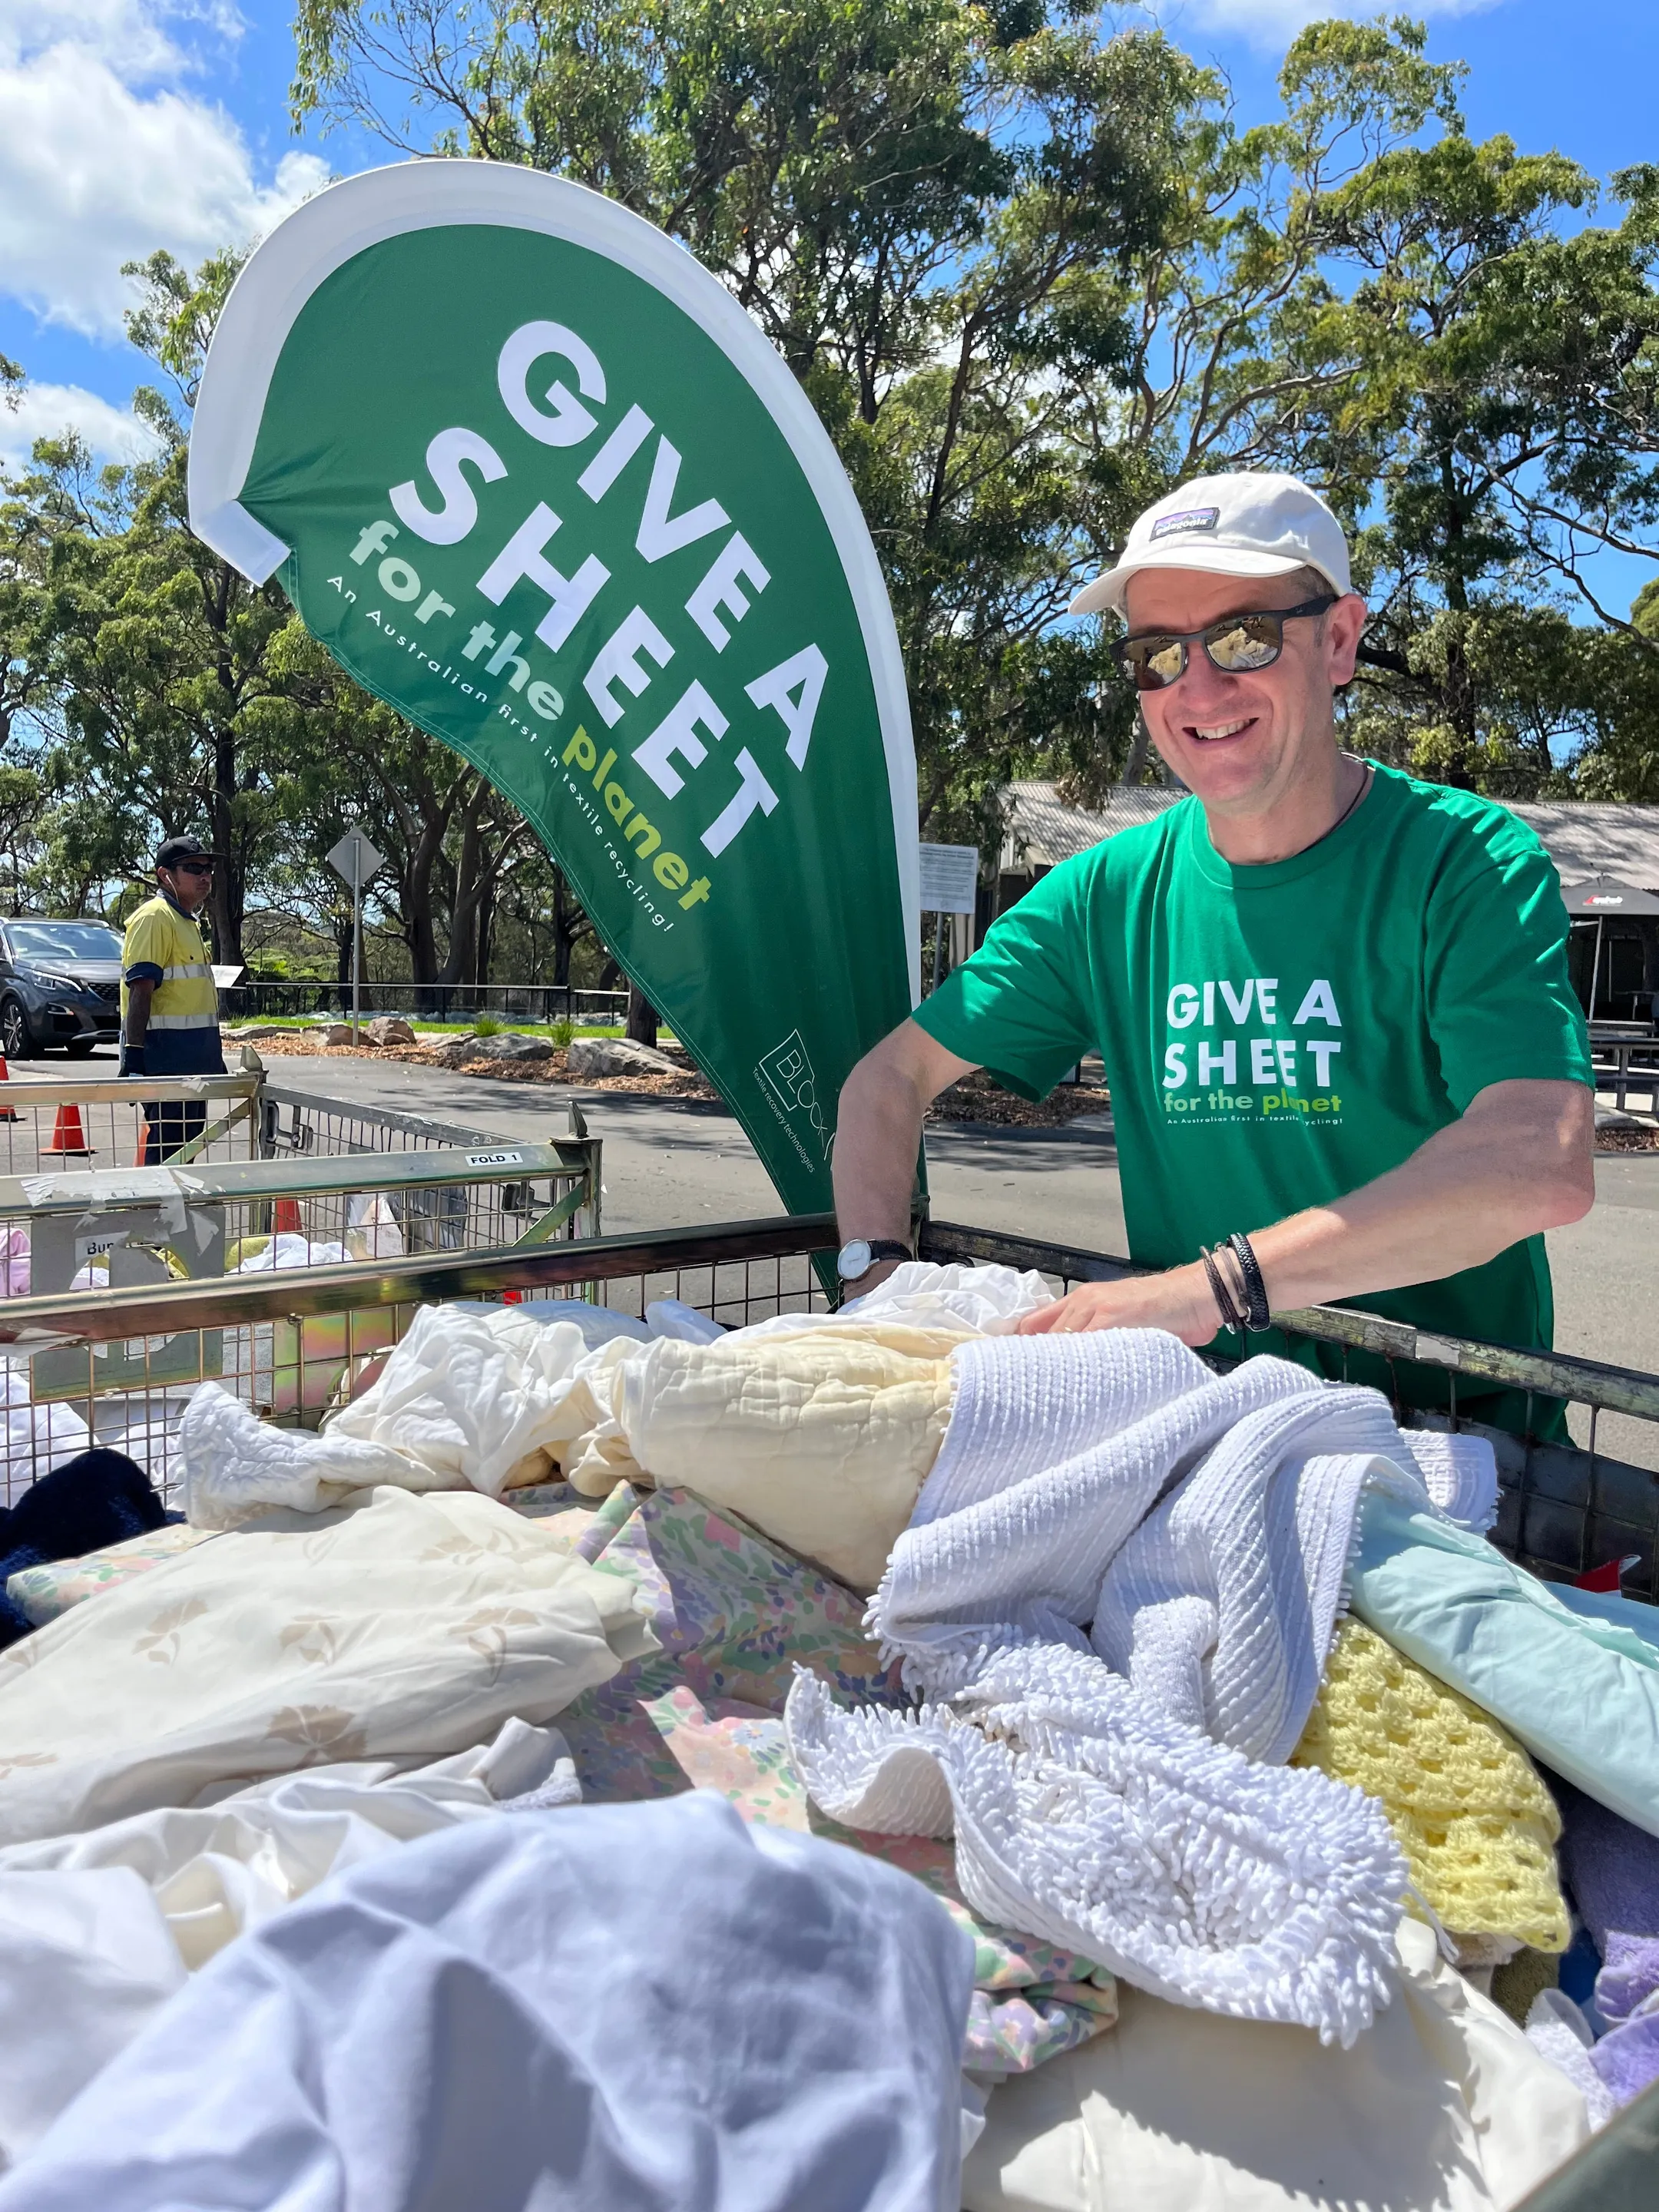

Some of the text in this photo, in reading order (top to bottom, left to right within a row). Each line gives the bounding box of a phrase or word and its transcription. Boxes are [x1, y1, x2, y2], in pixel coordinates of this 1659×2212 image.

[498, 320, 829, 771] GIVE A
[389, 428, 780, 859] SHEET
[327, 576, 674, 932] An Australian first in textile recycling!
[349, 520, 711, 910] for the planet
[1166, 978, 1343, 1029] GIVE A
[1161, 1038, 1342, 1089] SHEET
[1164, 1091, 1201, 1112] for
[1207, 1089, 1253, 1110] the
[470, 1155, 506, 1164] FOLD
[752, 1067, 816, 1174] Textile recovery technologies
[1181, 1116, 1227, 1124] Australian
